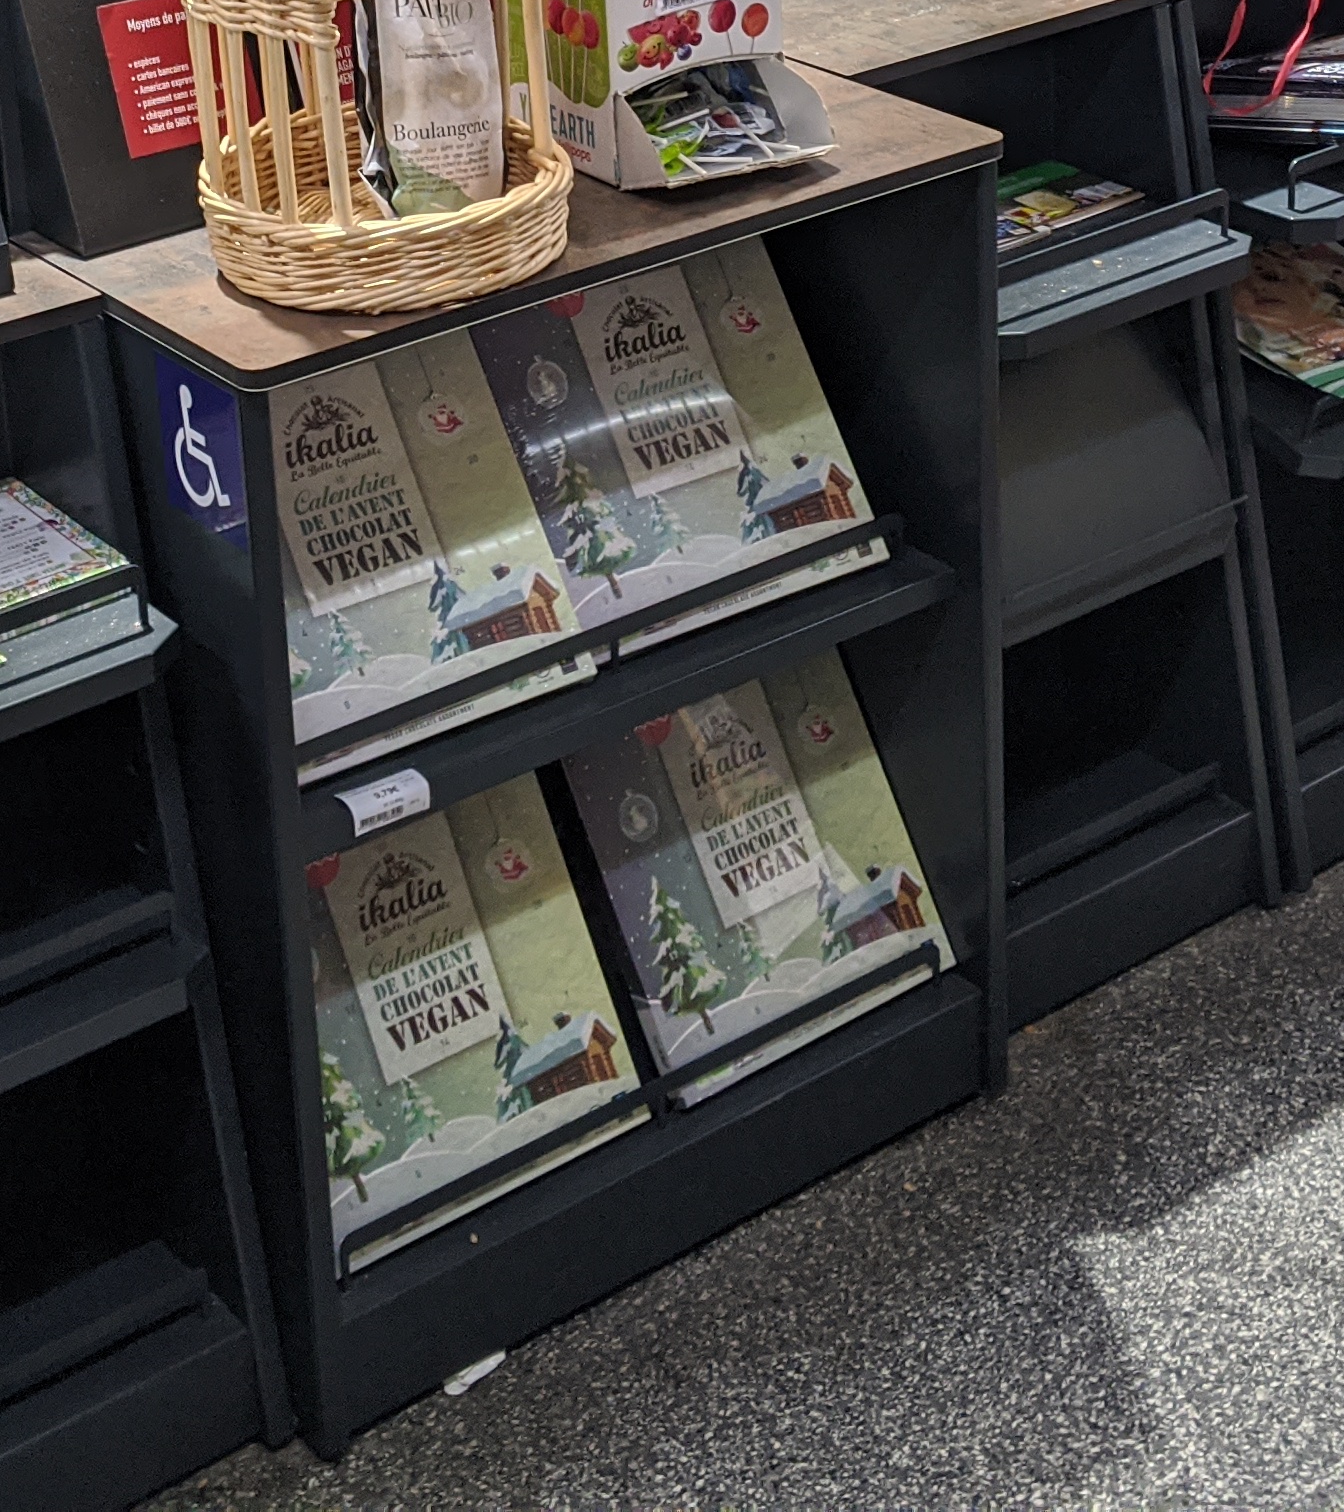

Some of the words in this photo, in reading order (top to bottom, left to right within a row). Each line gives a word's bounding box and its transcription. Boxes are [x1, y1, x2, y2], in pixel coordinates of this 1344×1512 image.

[126, 14, 161, 33] Moyens
[163, 12, 174, 25] de
[437, 1, 474, 29] BIO
[393, 117, 491, 143] Boulangerie
[550, 102, 597, 149] EARTH
[604, 321, 687, 363] ikalia
[284, 422, 379, 469] ikalia
[633, 420, 732, 470] VEGAN
[293, 471, 398, 516] Calendrier
[298, 514, 327, 536] DE
[330, 488, 407, 526] L'AVENT
[306, 506, 413, 557] CHOCOLAT
[312, 528, 424, 587] VEGAN
[720, 838, 812, 899] VEGAN
[357, 876, 449, 933] ikalia
[380, 963, 481, 1023] CHOCOLAT
[385, 983, 492, 1052] VEGAN
